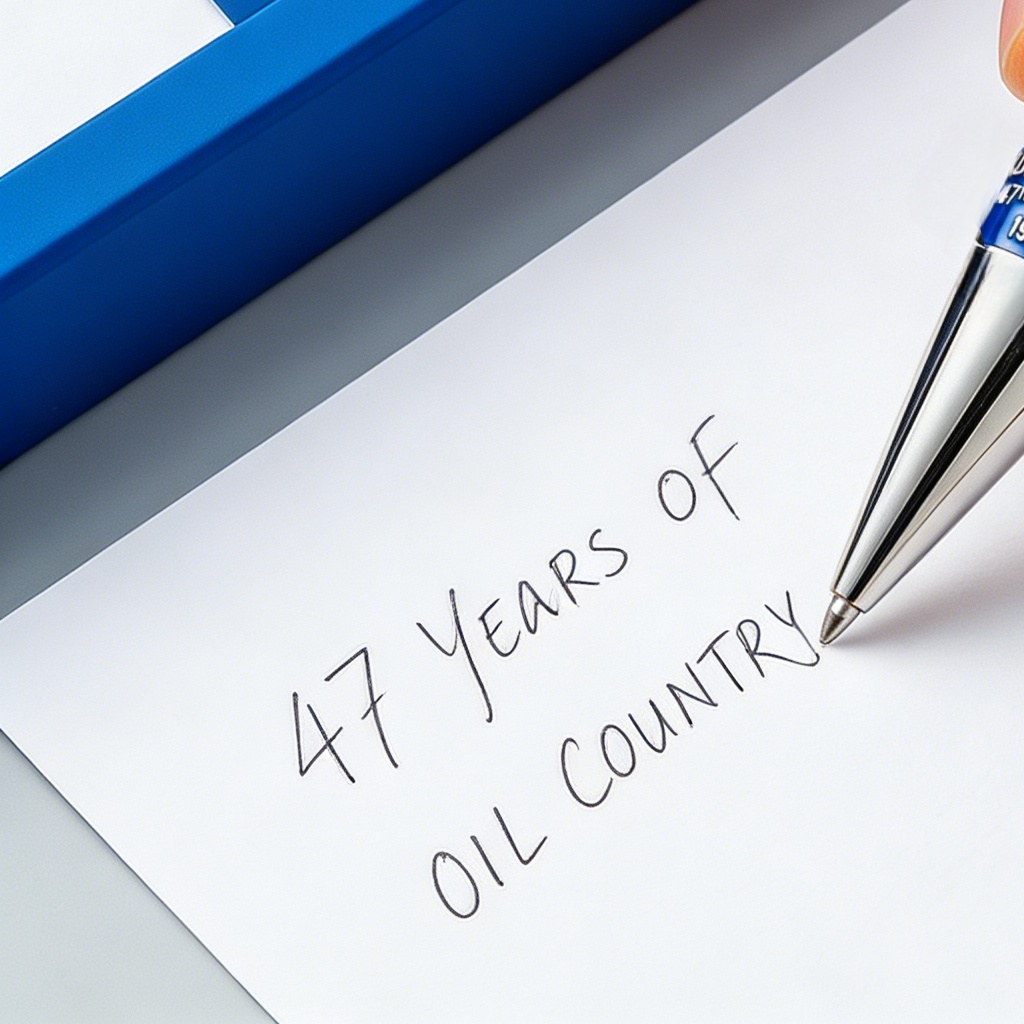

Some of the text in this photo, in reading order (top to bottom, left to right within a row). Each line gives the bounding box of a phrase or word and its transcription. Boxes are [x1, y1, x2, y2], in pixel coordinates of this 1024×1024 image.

[291, 414, 740, 783] 47 YEARS OF
[432, 590, 821, 918] OIL COUNTRY
